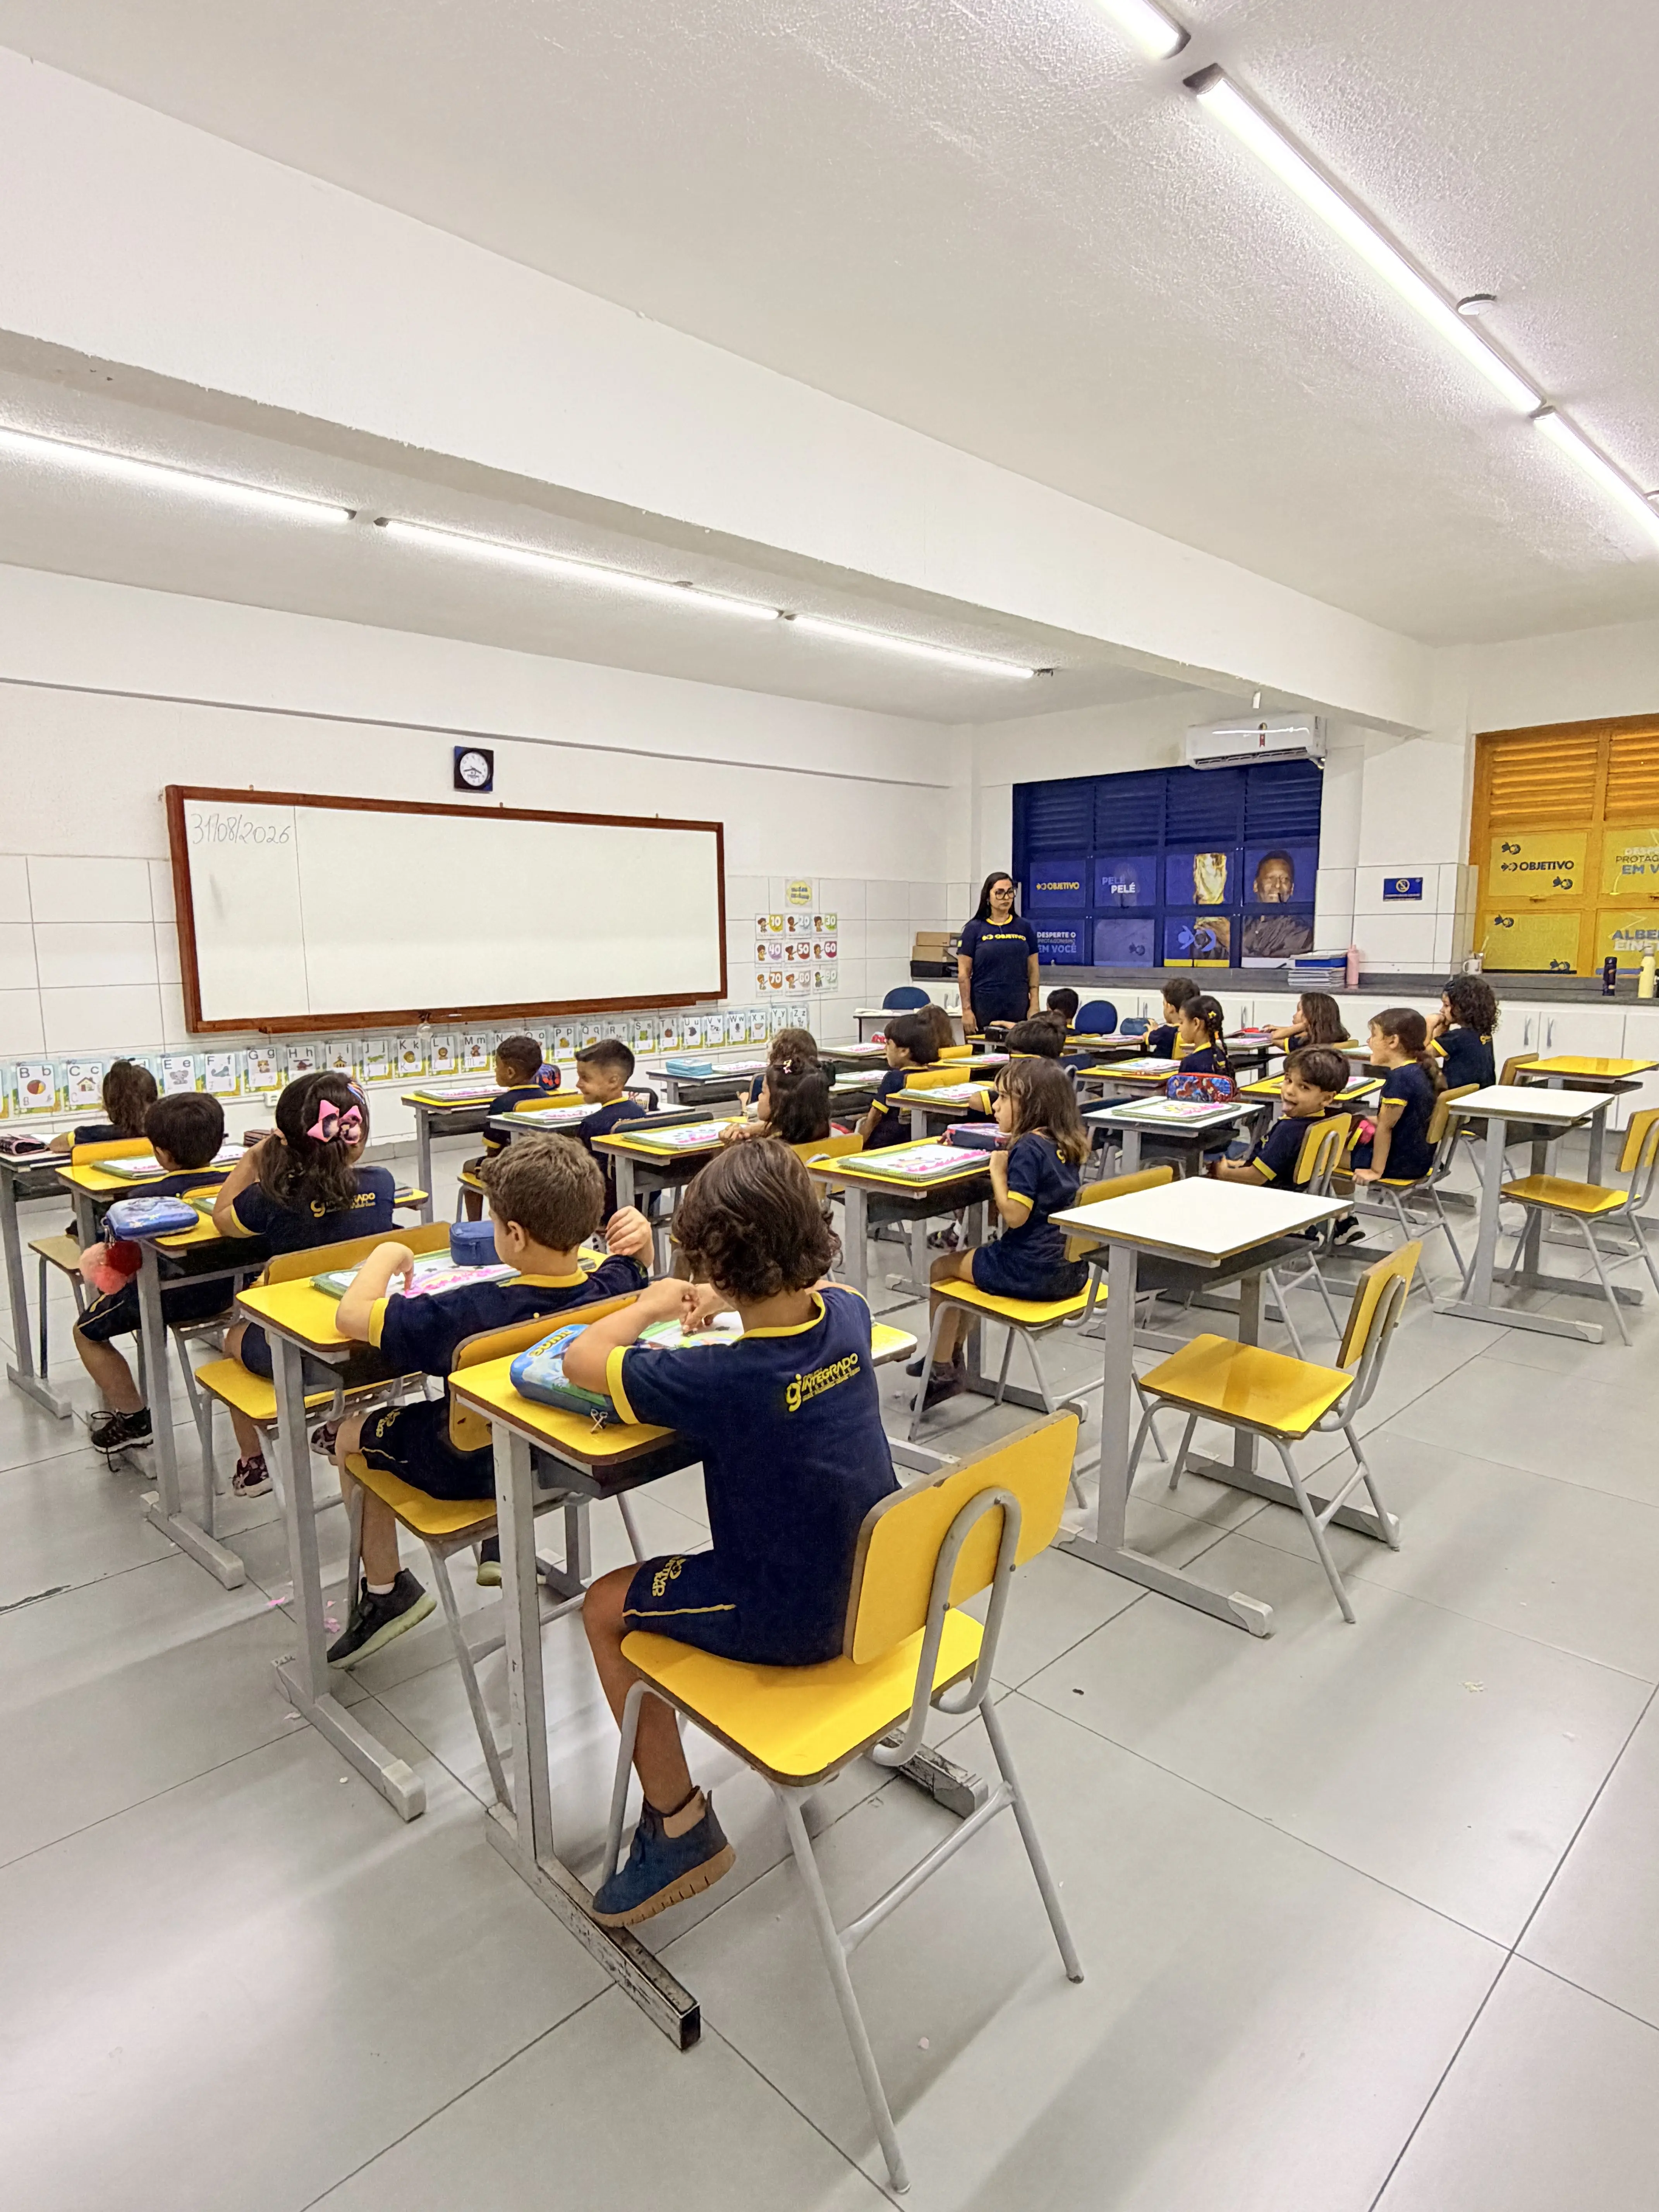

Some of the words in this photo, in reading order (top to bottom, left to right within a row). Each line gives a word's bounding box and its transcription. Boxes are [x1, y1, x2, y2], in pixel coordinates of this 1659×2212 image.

[191, 814, 290, 844] 31/08/2026
[1519, 860, 1574, 871] OBJETIVO
[1622, 864, 1645, 874] EM
[1047, 882, 1080, 890] OBJETIVO
[1111, 882, 1135, 894] PELÉ
[771, 916, 781, 926] 10
[799, 915, 810, 926] 20
[825, 915, 836, 925] 30
[1612, 929, 1659, 940] ALBE
[769, 944, 781, 955] 40
[798, 944, 809, 954] 50
[825, 943, 836, 953] 60
[770, 973, 781, 984] 70
[399, 1040, 407, 1050] K
[433, 1038, 439, 1047] L
[465, 1037, 473, 1045] M
[249, 1050, 259, 1060] G
[289, 1048, 297, 1058] H
[164, 1059, 172, 1070] E
[207, 1056, 215, 1065] F
[20, 1067, 30, 1079] B
[69, 1066, 81, 1076] C
[802, 1353, 858, 1394] INTEGRADO
